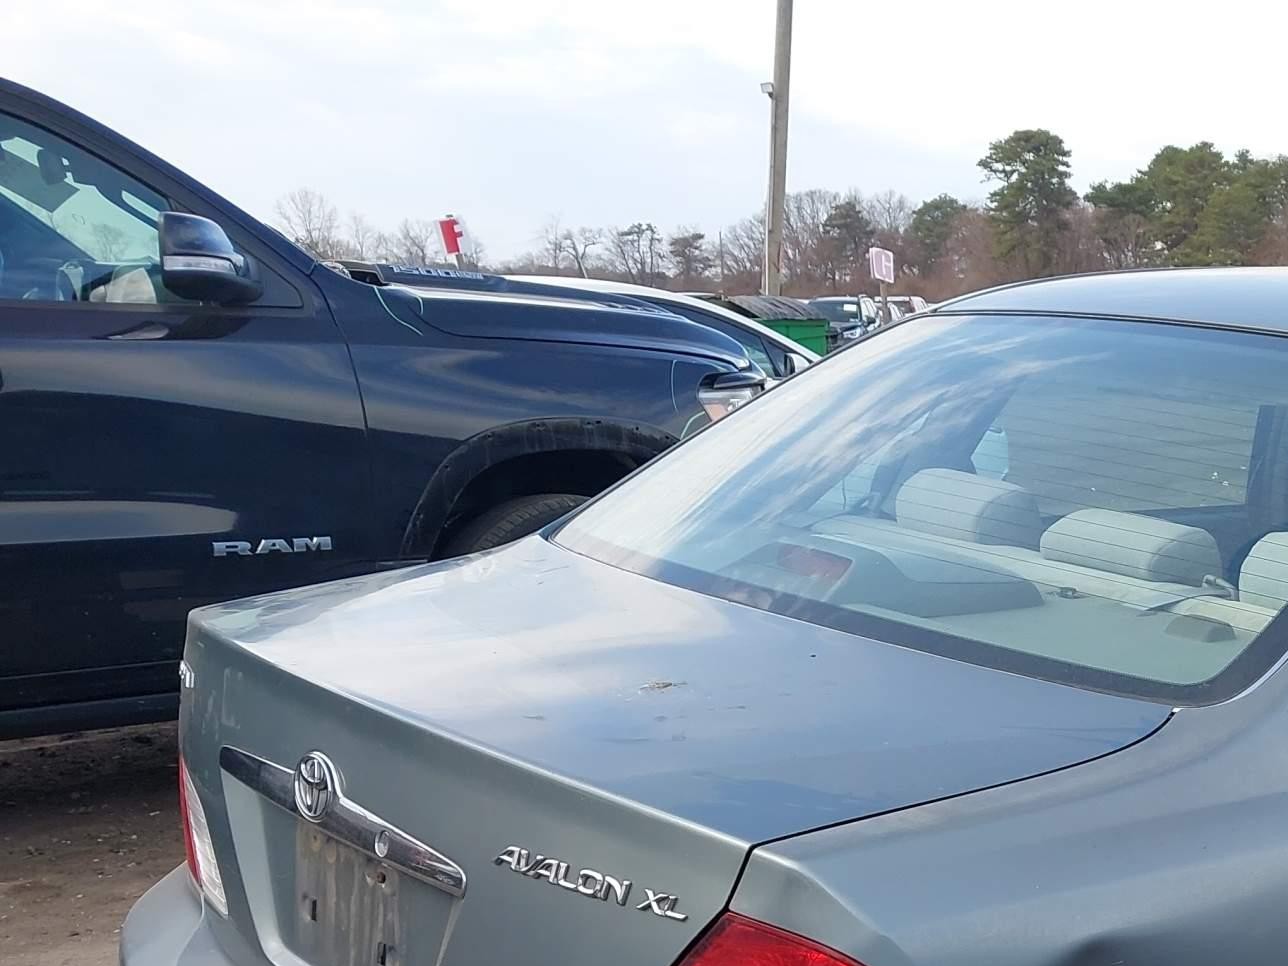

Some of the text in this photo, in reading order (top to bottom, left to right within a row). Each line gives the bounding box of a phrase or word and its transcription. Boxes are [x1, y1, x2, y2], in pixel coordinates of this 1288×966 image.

[212, 536, 332, 557] RAM
[494, 845, 689, 922] AVALON XL
